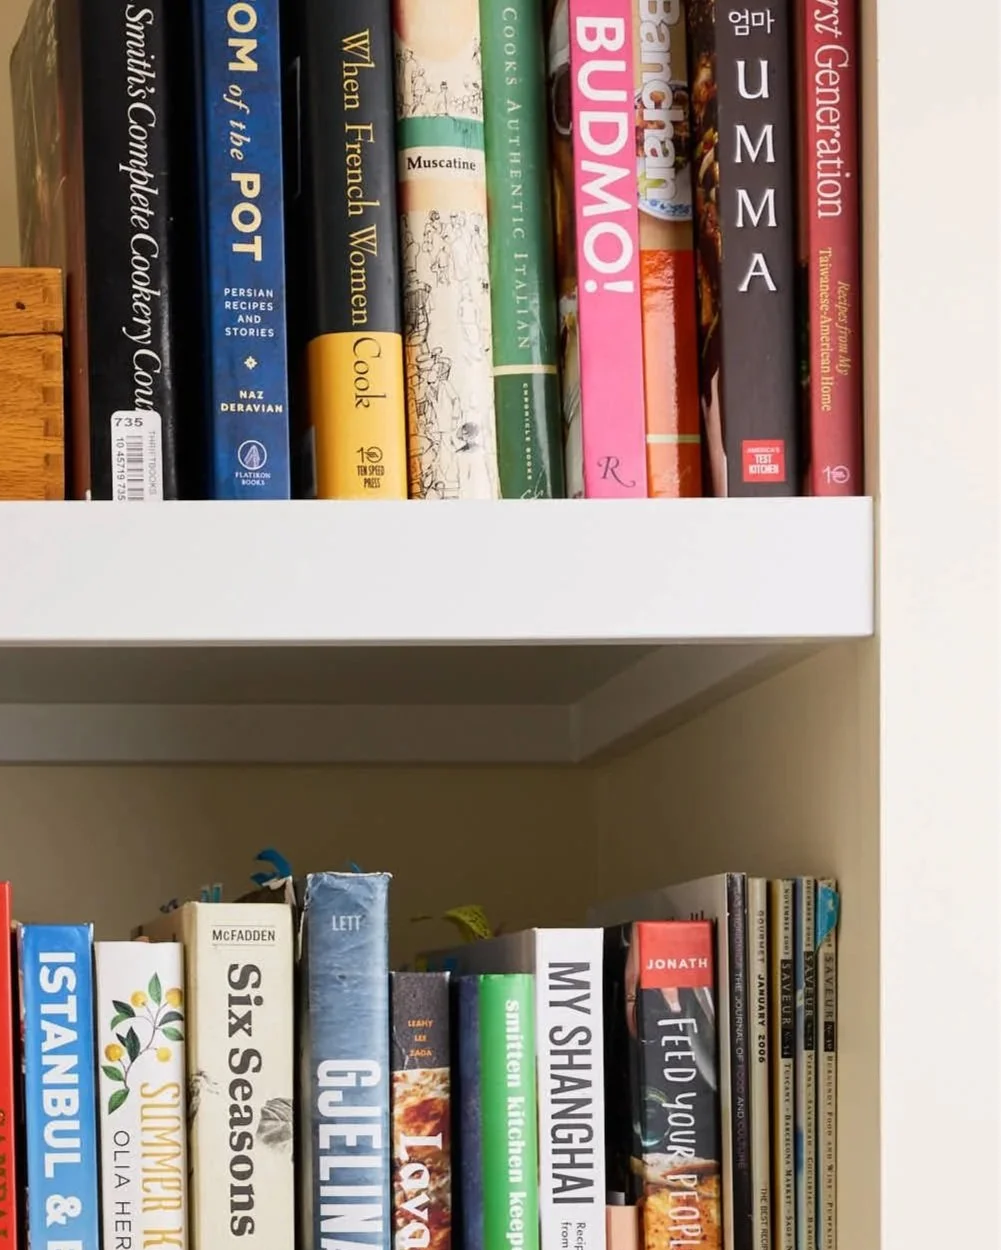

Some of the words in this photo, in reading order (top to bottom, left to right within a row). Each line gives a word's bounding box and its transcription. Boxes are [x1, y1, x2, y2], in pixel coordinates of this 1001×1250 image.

[125, 4, 156, 99] Smith's
[727, 9, 776, 36] 엄마
[225, 84, 250, 107] of
[342, 29, 373, 110] When
[120, 102, 159, 228] Complete
[229, 119, 248, 160] the
[346, 122, 379, 217] French
[407, 156, 476, 171] Muscatine
[576, 16, 633, 293] BUDMO!
[735, 58, 778, 294] UMMA
[231, 172, 262, 261] POT
[122, 233, 162, 344] Cookery
[223, 287, 274, 298] PERSIAN
[223, 300, 274, 311] RECIPES
[348, 224, 378, 325] Women
[225, 327, 275, 337] STORIES
[237, 314, 262, 324] AND
[239, 389, 265, 400] NAZ
[350, 337, 387, 409] Cook
[114, 416, 143, 428] 735
[220, 402, 283, 413] DERAVIAN
[332, 915, 361, 931] LETT
[548, 961, 591, 1014] MY
[646, 957, 708, 970] JONATH
[227, 963, 264, 1037] Six
[38, 952, 81, 1178] ISTANBUL
[505, 1000, 524, 1087] smitten
[657, 1017, 698, 1083] FEED
[139, 1081, 183, 1213] SUMMER
[228, 1047, 263, 1237] Seasons
[507, 1095, 526, 1182] kitchen
[548, 1025, 594, 1205] SHANGHAI
[661, 1091, 698, 1158] YOUR
[113, 1129, 131, 1189] OLIA
[46, 1193, 81, 1228] &
[561, 1222, 571, 1249] from
